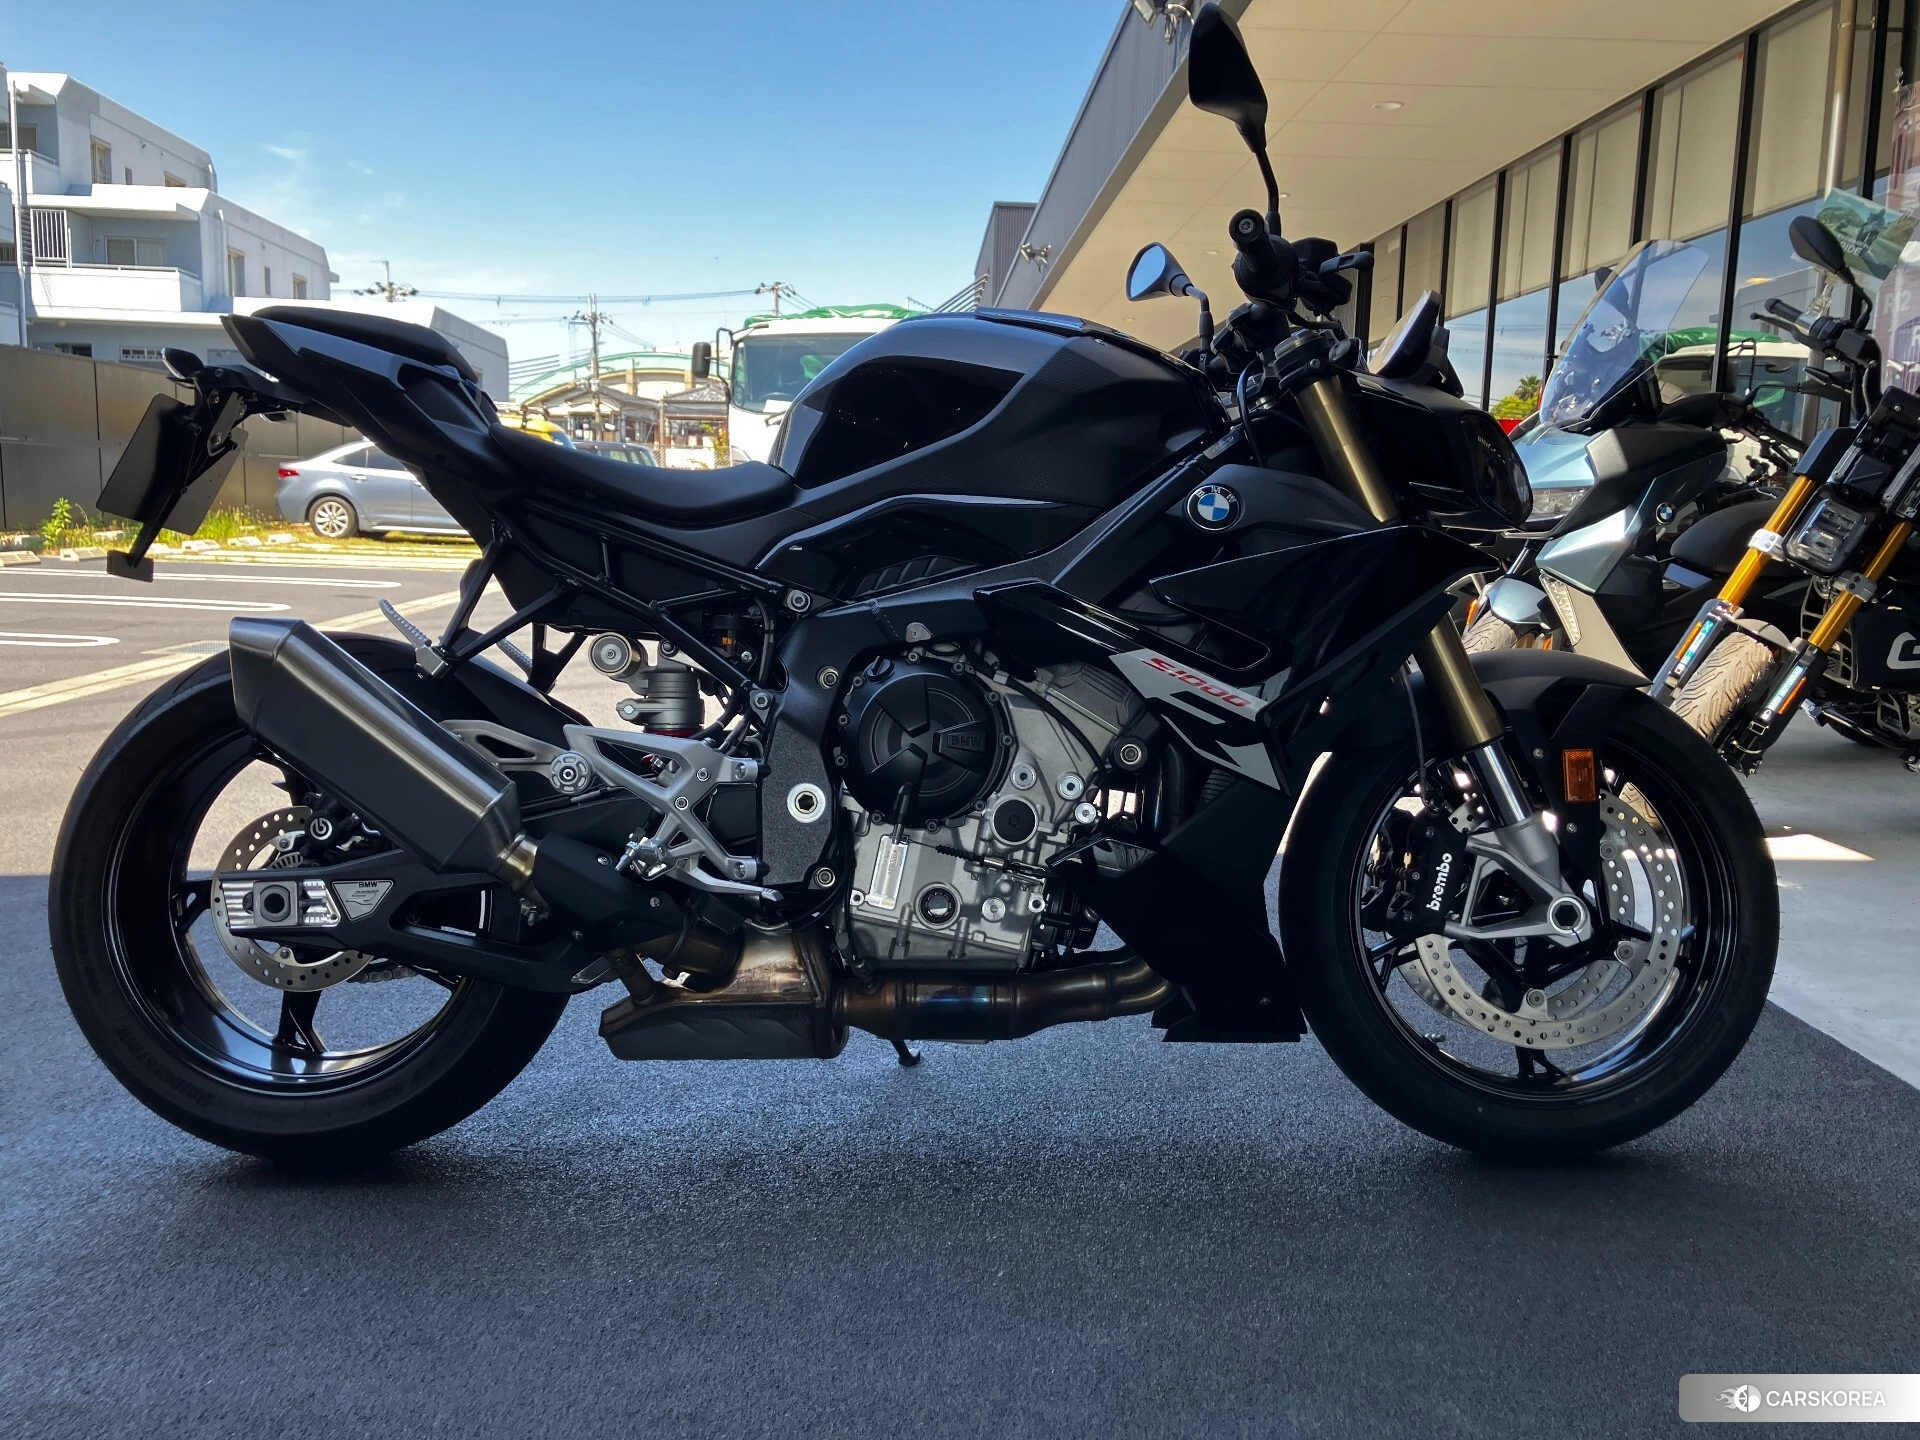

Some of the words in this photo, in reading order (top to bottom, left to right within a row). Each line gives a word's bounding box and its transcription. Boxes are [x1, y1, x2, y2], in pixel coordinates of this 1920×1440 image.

[1195, 485, 1237, 503] BMW
[951, 736, 982, 747] BMW
[1426, 853, 1453, 911] brembo
